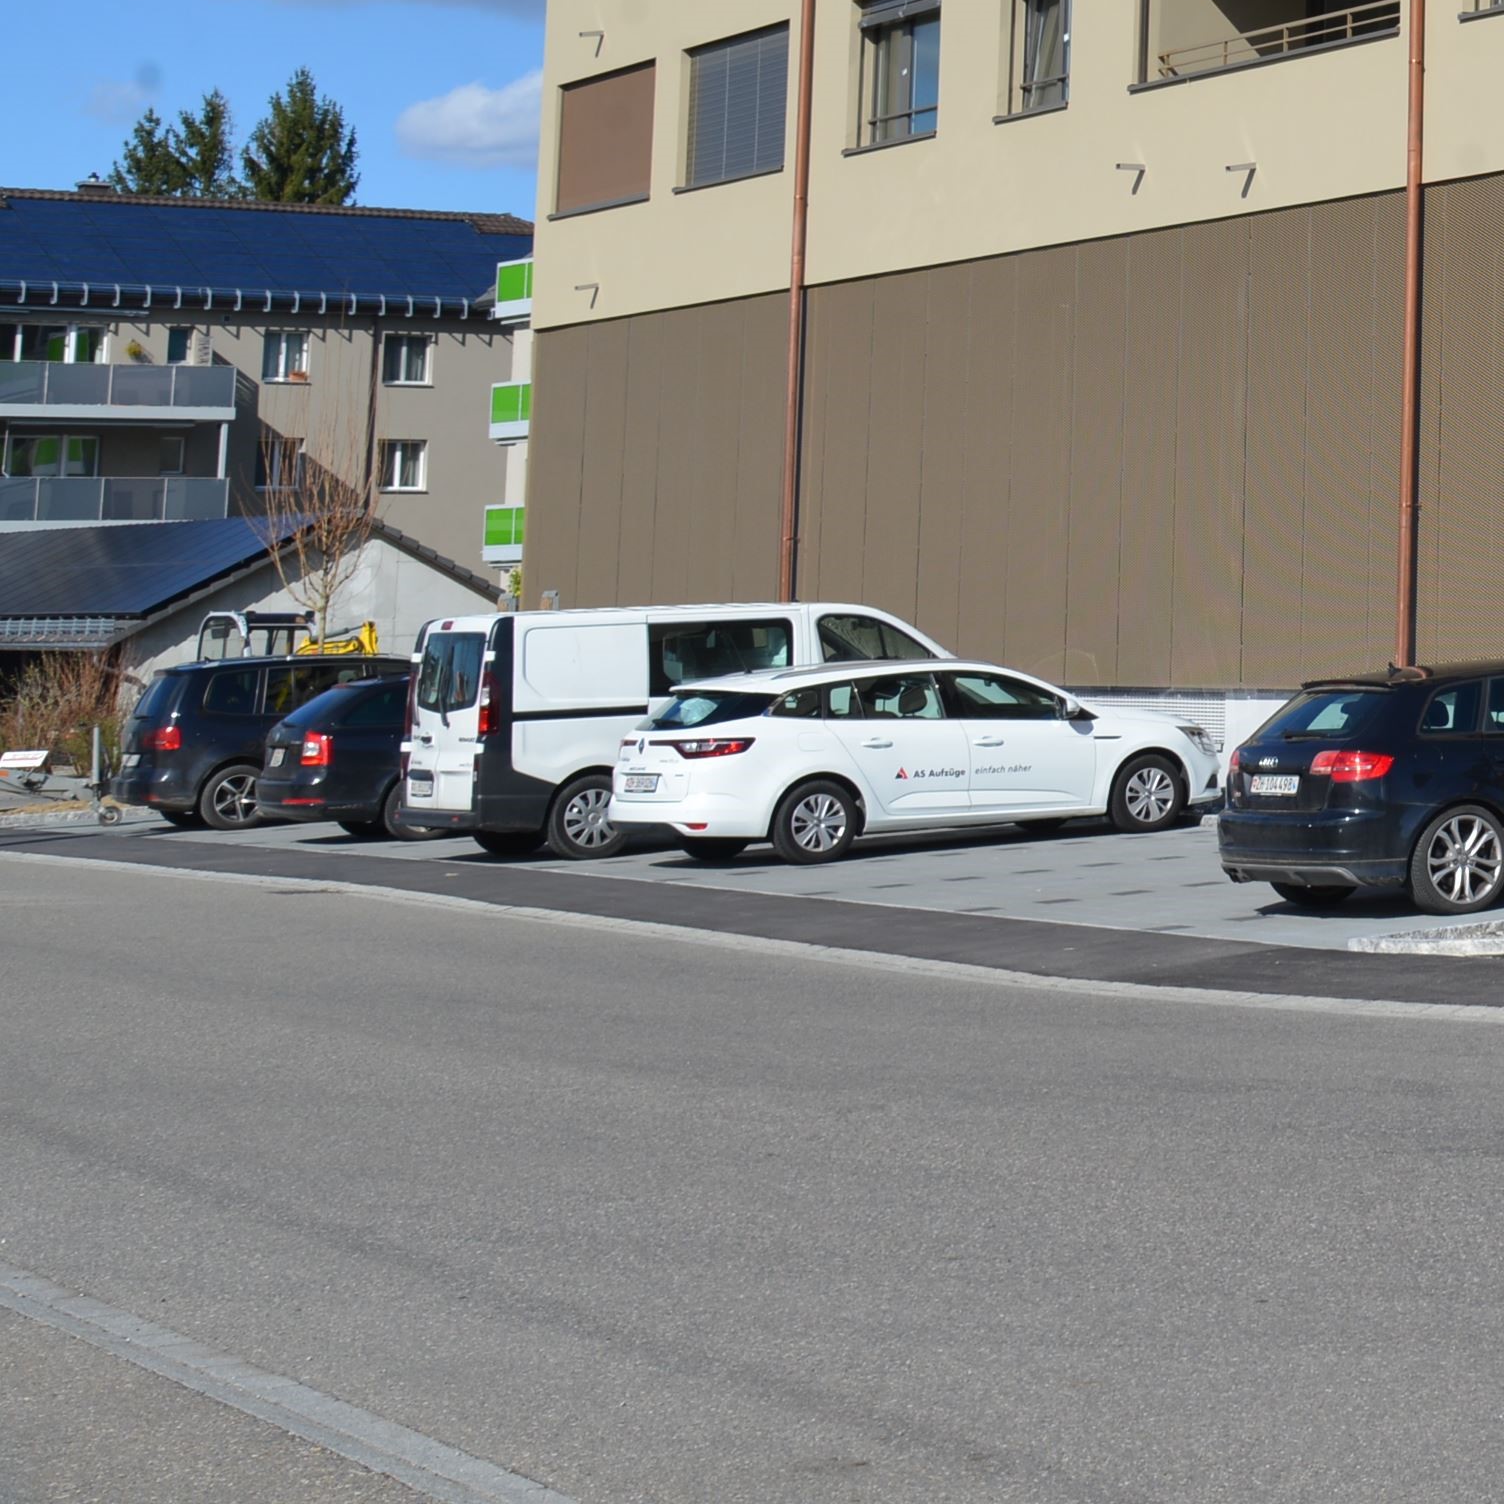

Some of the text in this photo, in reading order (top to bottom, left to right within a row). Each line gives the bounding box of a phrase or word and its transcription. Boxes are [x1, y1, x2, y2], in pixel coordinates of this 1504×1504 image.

[913, 764, 1032, 778] AS Aufzüge einfach näher
